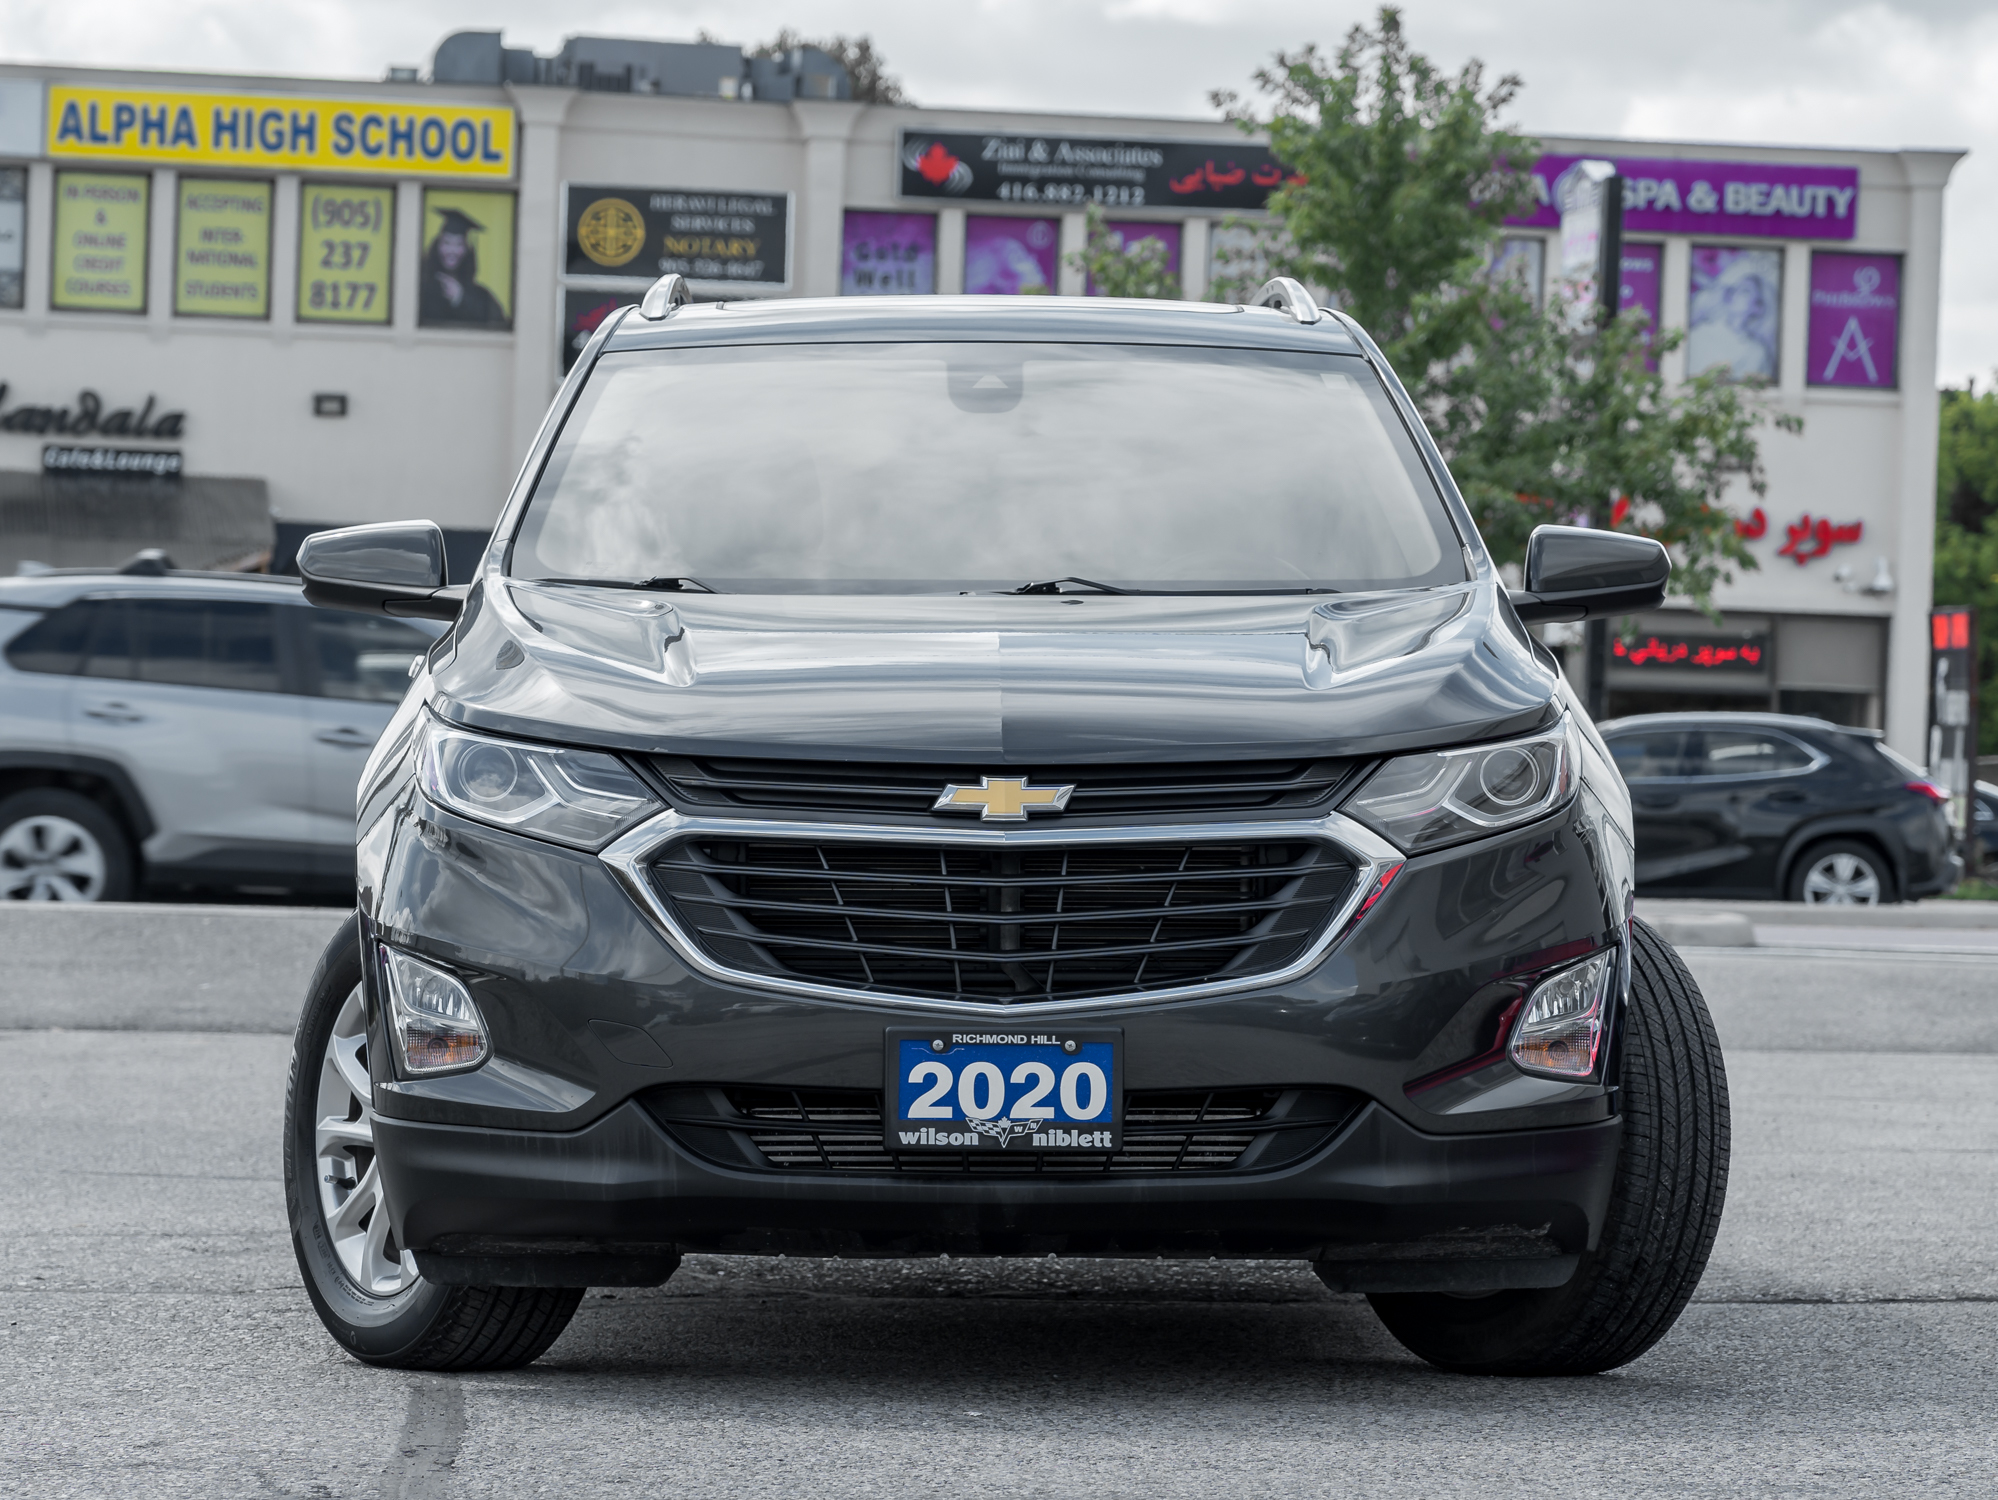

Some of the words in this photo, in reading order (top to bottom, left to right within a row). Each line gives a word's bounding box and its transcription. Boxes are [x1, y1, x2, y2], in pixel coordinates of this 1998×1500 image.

[57, 100, 198, 148] ALPHA
[211, 107, 318, 155] HIGH
[331, 113, 504, 163] SCHOOL
[1028, 138, 1050, 163] &
[1054, 140, 1163, 168] Associates
[186, 194, 265, 217] ACCEPTING
[1623, 178, 1681, 212] SPA
[1687, 181, 1718, 214] &
[1724, 182, 1855, 219] BEAUTY
[311, 193, 383, 235] (905)
[670, 213, 756, 235] SERVICES
[72, 230, 127, 251] ONLINE
[663, 235, 761, 259] NOTARY
[854, 241, 920, 263] Gold
[186, 248, 258, 269] NATIONAL
[320, 239, 371, 271] 237
[65, 277, 131, 298] COURSES
[185, 280, 259, 300] STUDENTS
[853, 267, 917, 290] Well
[309, 279, 378, 313] 8177
[0, 381, 185, 437] andala
[952, 1033, 1028, 1045] RICHMOND
[1030, 1034, 1061, 1045] HILL
[907, 1061, 1107, 1121] 2020
[898, 1127, 979, 1146] wilson
[1032, 1129, 1112, 1148] niblett
